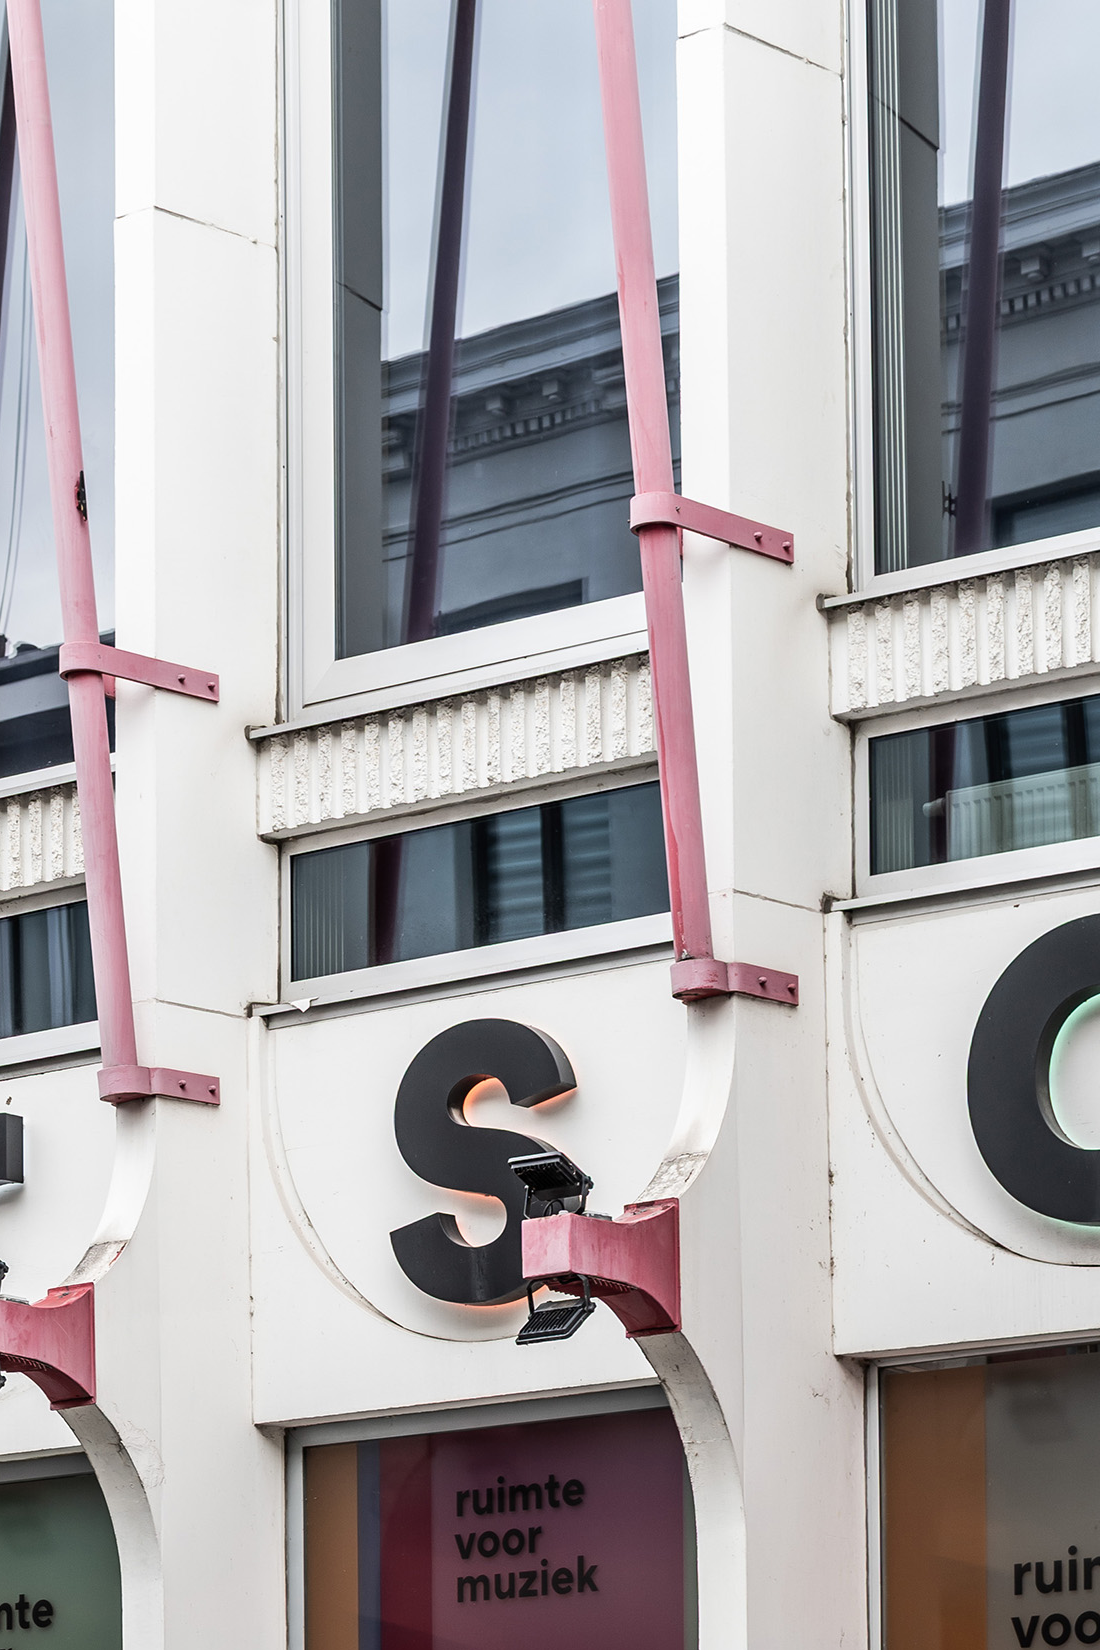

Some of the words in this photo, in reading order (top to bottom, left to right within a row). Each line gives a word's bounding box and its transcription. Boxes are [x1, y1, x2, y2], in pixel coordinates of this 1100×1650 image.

[456, 1473, 586, 1518] ruimte
[454, 1525, 543, 1560] voor
[456, 1555, 599, 1603] muziek
